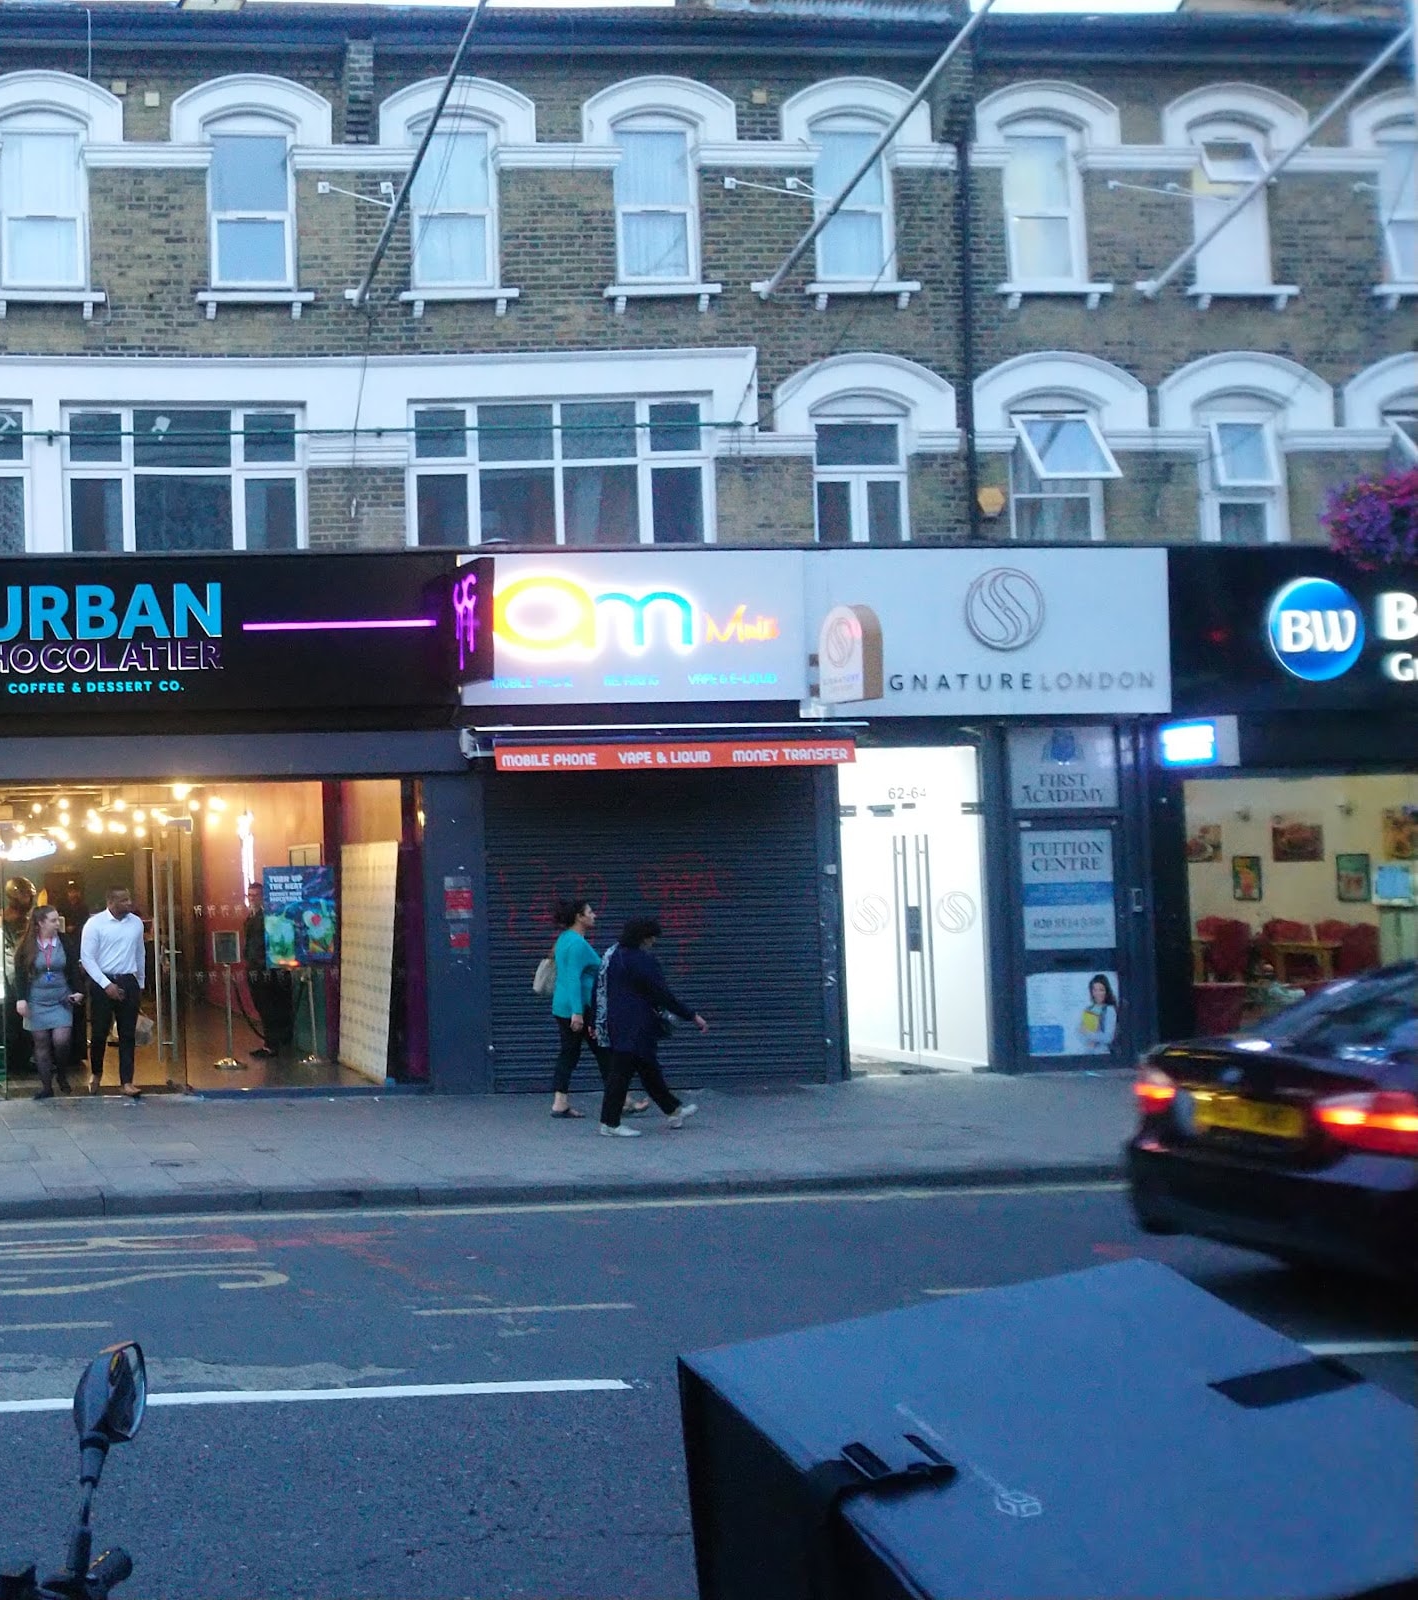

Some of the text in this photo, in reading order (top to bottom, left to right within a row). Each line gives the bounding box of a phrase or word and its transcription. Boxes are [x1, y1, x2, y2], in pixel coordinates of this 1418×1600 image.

[1281, 609, 1357, 653] BW
[8, 680, 185, 694] COFFEE & DESSERT CO.
[889, 671, 1156, 692] GNATURE LONDON
[501, 752, 598, 767] MOBILE PHONE
[618, 750, 712, 765] VAPE & LIQUID
[732, 747, 848, 762] MONEY TRANSFER
[1039, 773, 1088, 788] FIRST
[888, 786, 927, 800] 62-64
[1022, 784, 1103, 803] ACADEMY
[1029, 841, 1104, 856] TUITION
[1031, 856, 1102, 873] CENTRE
